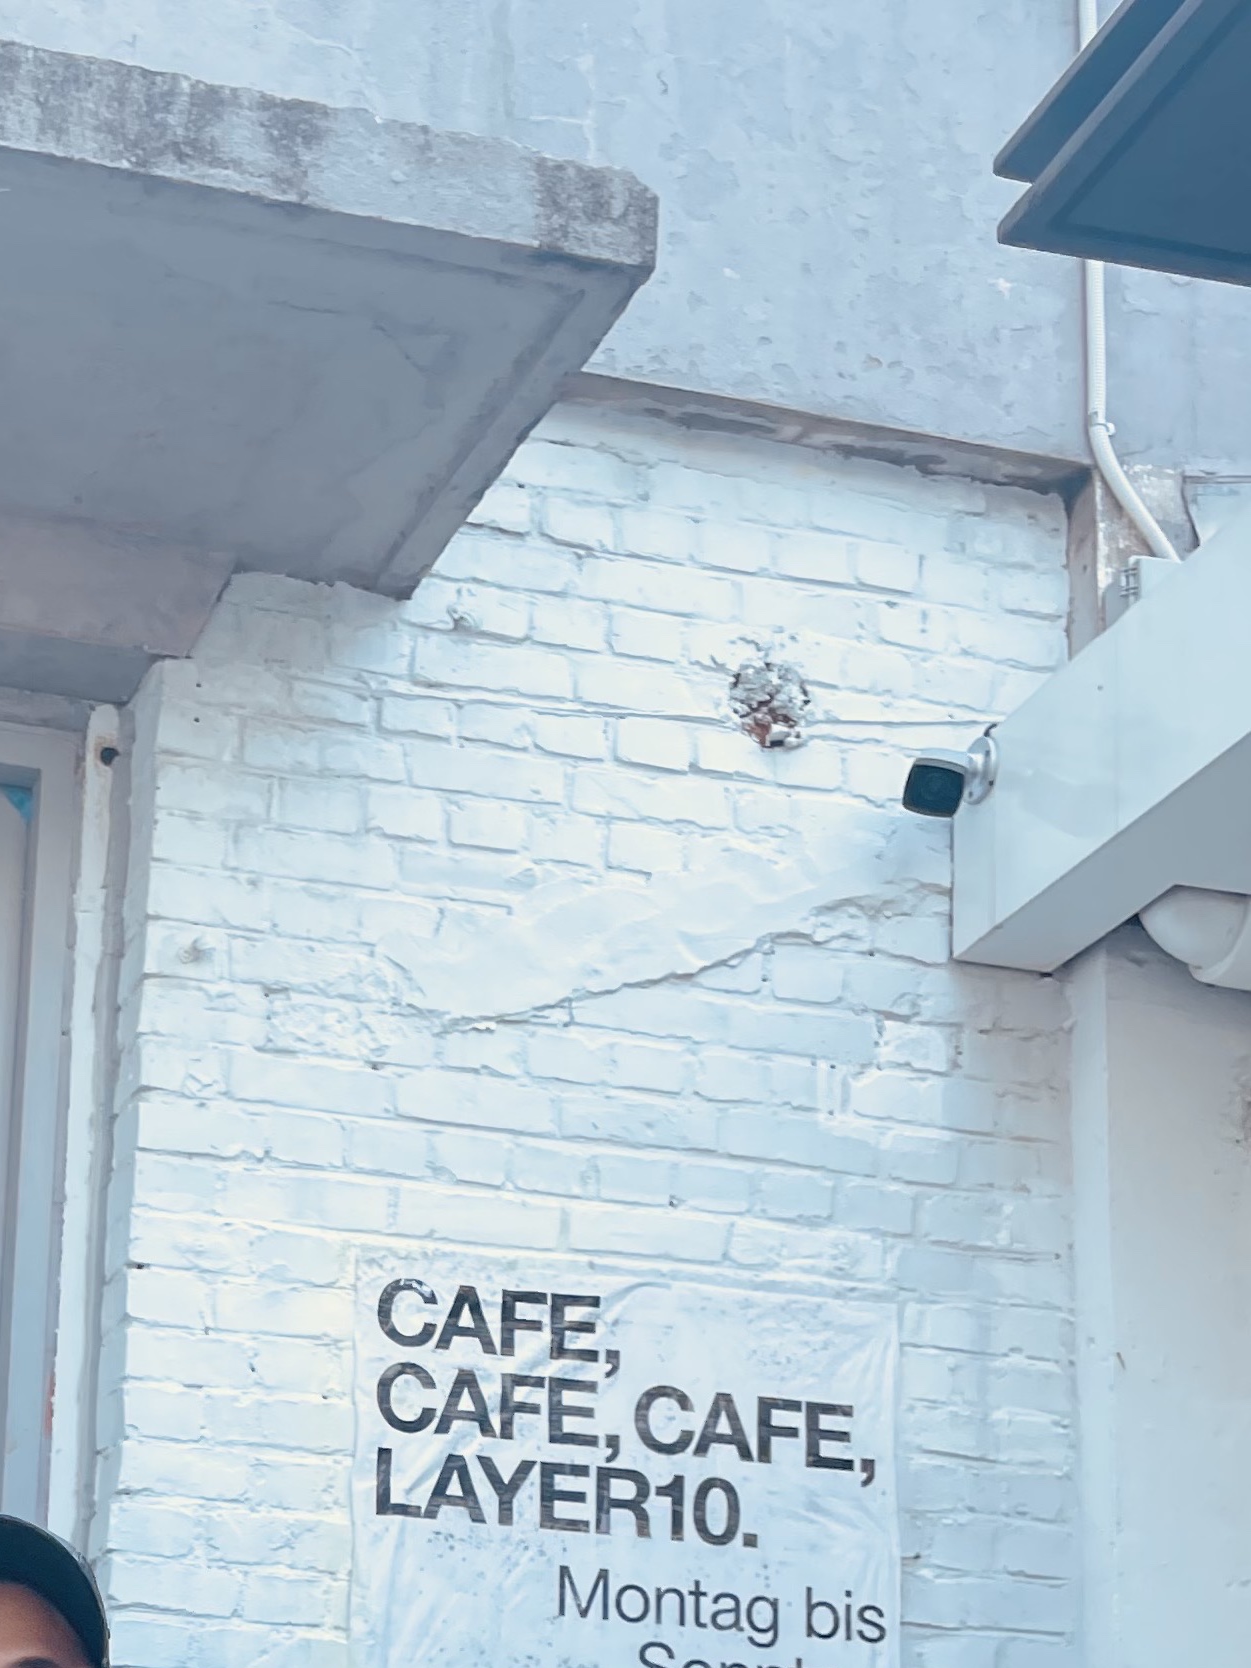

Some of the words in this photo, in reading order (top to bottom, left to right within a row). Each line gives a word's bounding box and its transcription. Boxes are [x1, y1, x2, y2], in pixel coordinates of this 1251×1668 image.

[377, 1278, 621, 1378] CAFE,
[375, 1362, 621, 1463] CAFE,
[634, 1385, 876, 1488] CAFE,
[375, 1447, 758, 1549] LAYER10.
[558, 1565, 779, 1648] Montag
[806, 1586, 887, 1644] bis
